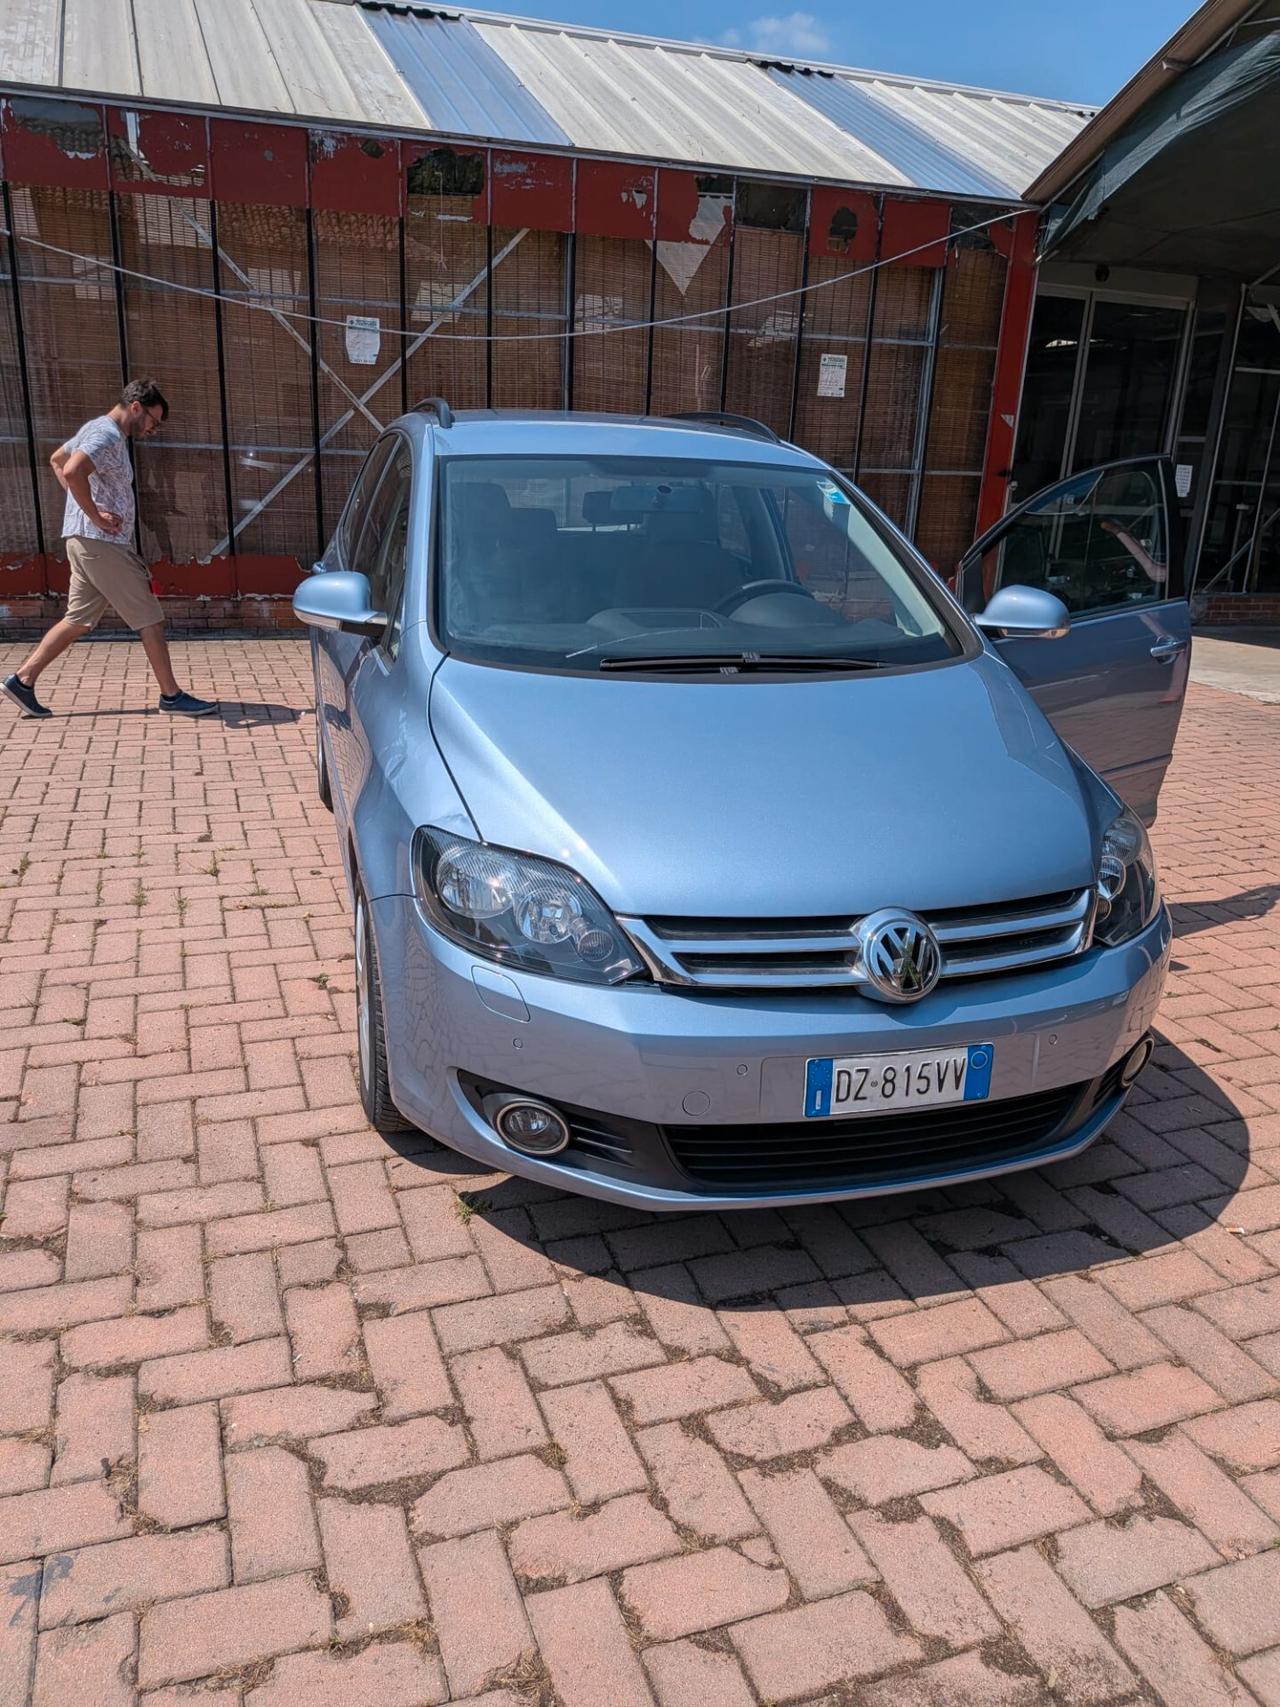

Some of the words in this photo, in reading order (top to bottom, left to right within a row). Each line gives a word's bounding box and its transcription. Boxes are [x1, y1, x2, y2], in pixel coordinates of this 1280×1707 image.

[868, 919, 937, 997] VW
[835, 1068, 870, 1103] DZ
[881, 1057, 966, 1099] 815VV
